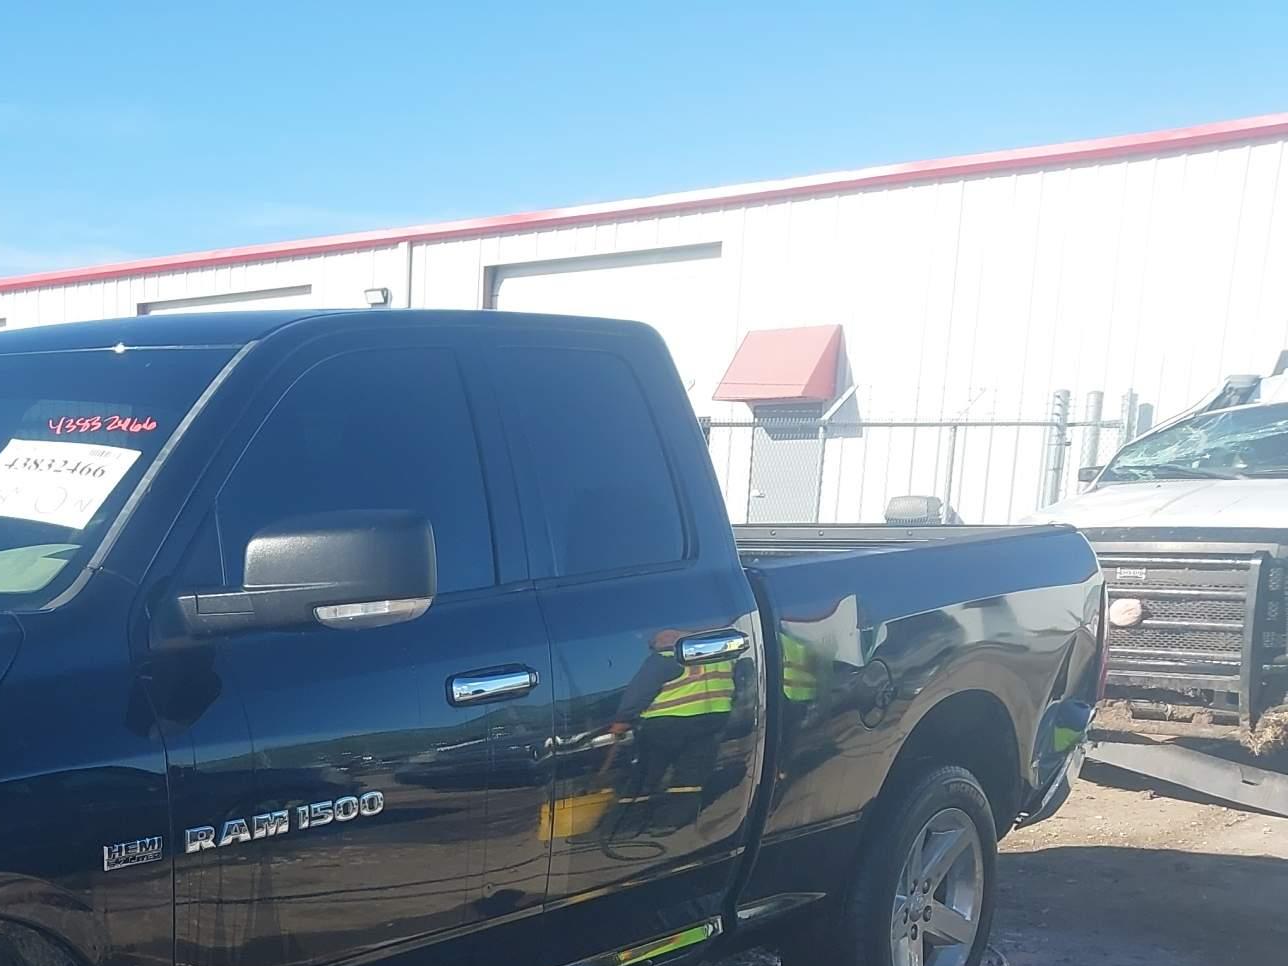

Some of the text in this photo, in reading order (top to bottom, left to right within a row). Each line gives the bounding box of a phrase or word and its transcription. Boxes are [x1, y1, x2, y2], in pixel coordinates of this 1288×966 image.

[4, 457, 107, 479] 43832466
[185, 790, 385, 854] RAM 1500
[104, 836, 163, 860] HEMI
